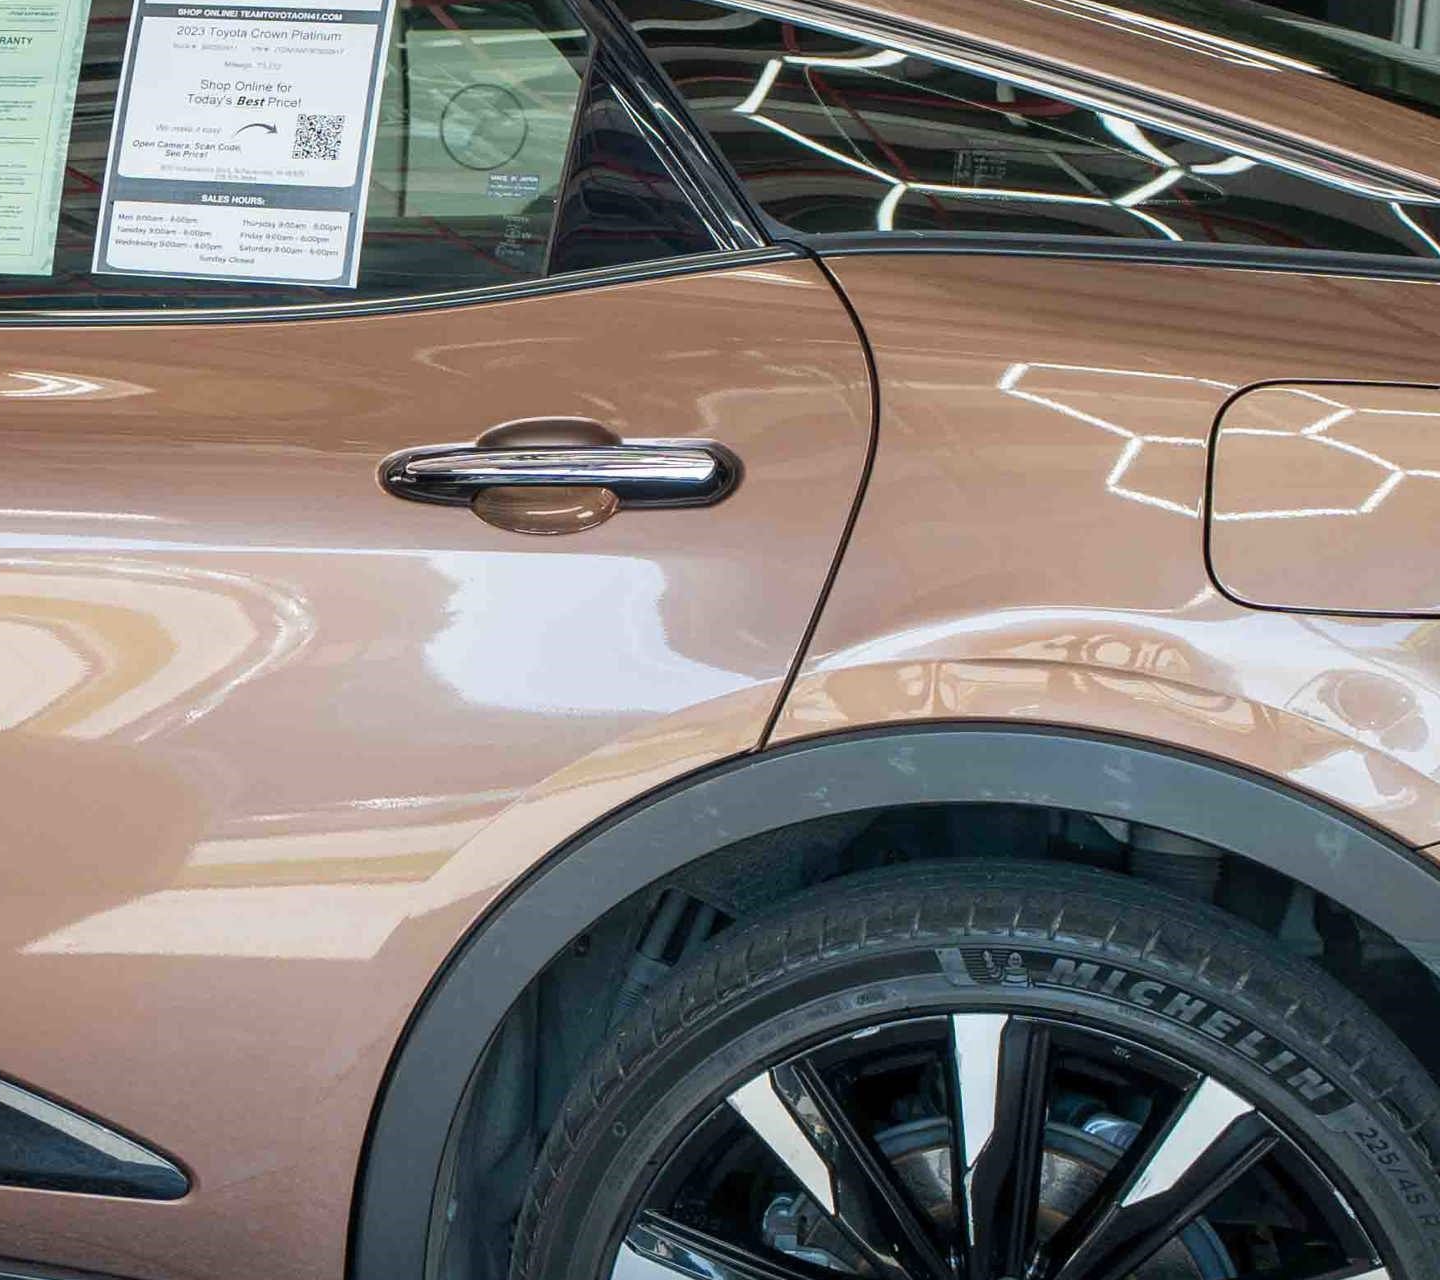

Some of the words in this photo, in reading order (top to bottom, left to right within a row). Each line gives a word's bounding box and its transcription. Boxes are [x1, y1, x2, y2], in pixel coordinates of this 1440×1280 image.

[177, 8, 202, 17] SHOP
[204, 9, 239, 18] ONLINE!
[240, 10, 343, 21] TEAMTOYOTAON41.COM
[177, 25, 205, 37] 2023
[209, 26, 247, 40] Toyota
[250, 28, 288, 40] Crown
[291, 29, 342, 42] Platinum
[200, 79, 231, 93] Shop
[234, 80, 273, 92] Online
[276, 82, 292, 93] for
[187, 93, 233, 106] Today's
[236, 95, 265, 107] Best
[267, 97, 302, 109] Price!
[132, 140, 156, 149] Open
[194, 142, 216, 150] Scan
[165, 149, 181, 157] See
[182, 150, 209, 159] Price!
[201, 194, 230, 204] SALES
[231, 195, 265, 206] HOURS:
[117, 225, 146, 234] Tuesday
[242, 219, 276, 229] Thursday
[240, 231, 263, 240] Friday
[115, 238, 158, 248] Wednesday
[239, 244, 273, 254] Saturday
[198, 254, 227, 265] Sunday
[228, 256, 256, 265] Closed
[1045, 957, 1335, 1102] MICHELIN
[1355, 1127, 1428, 1206] 225/45
